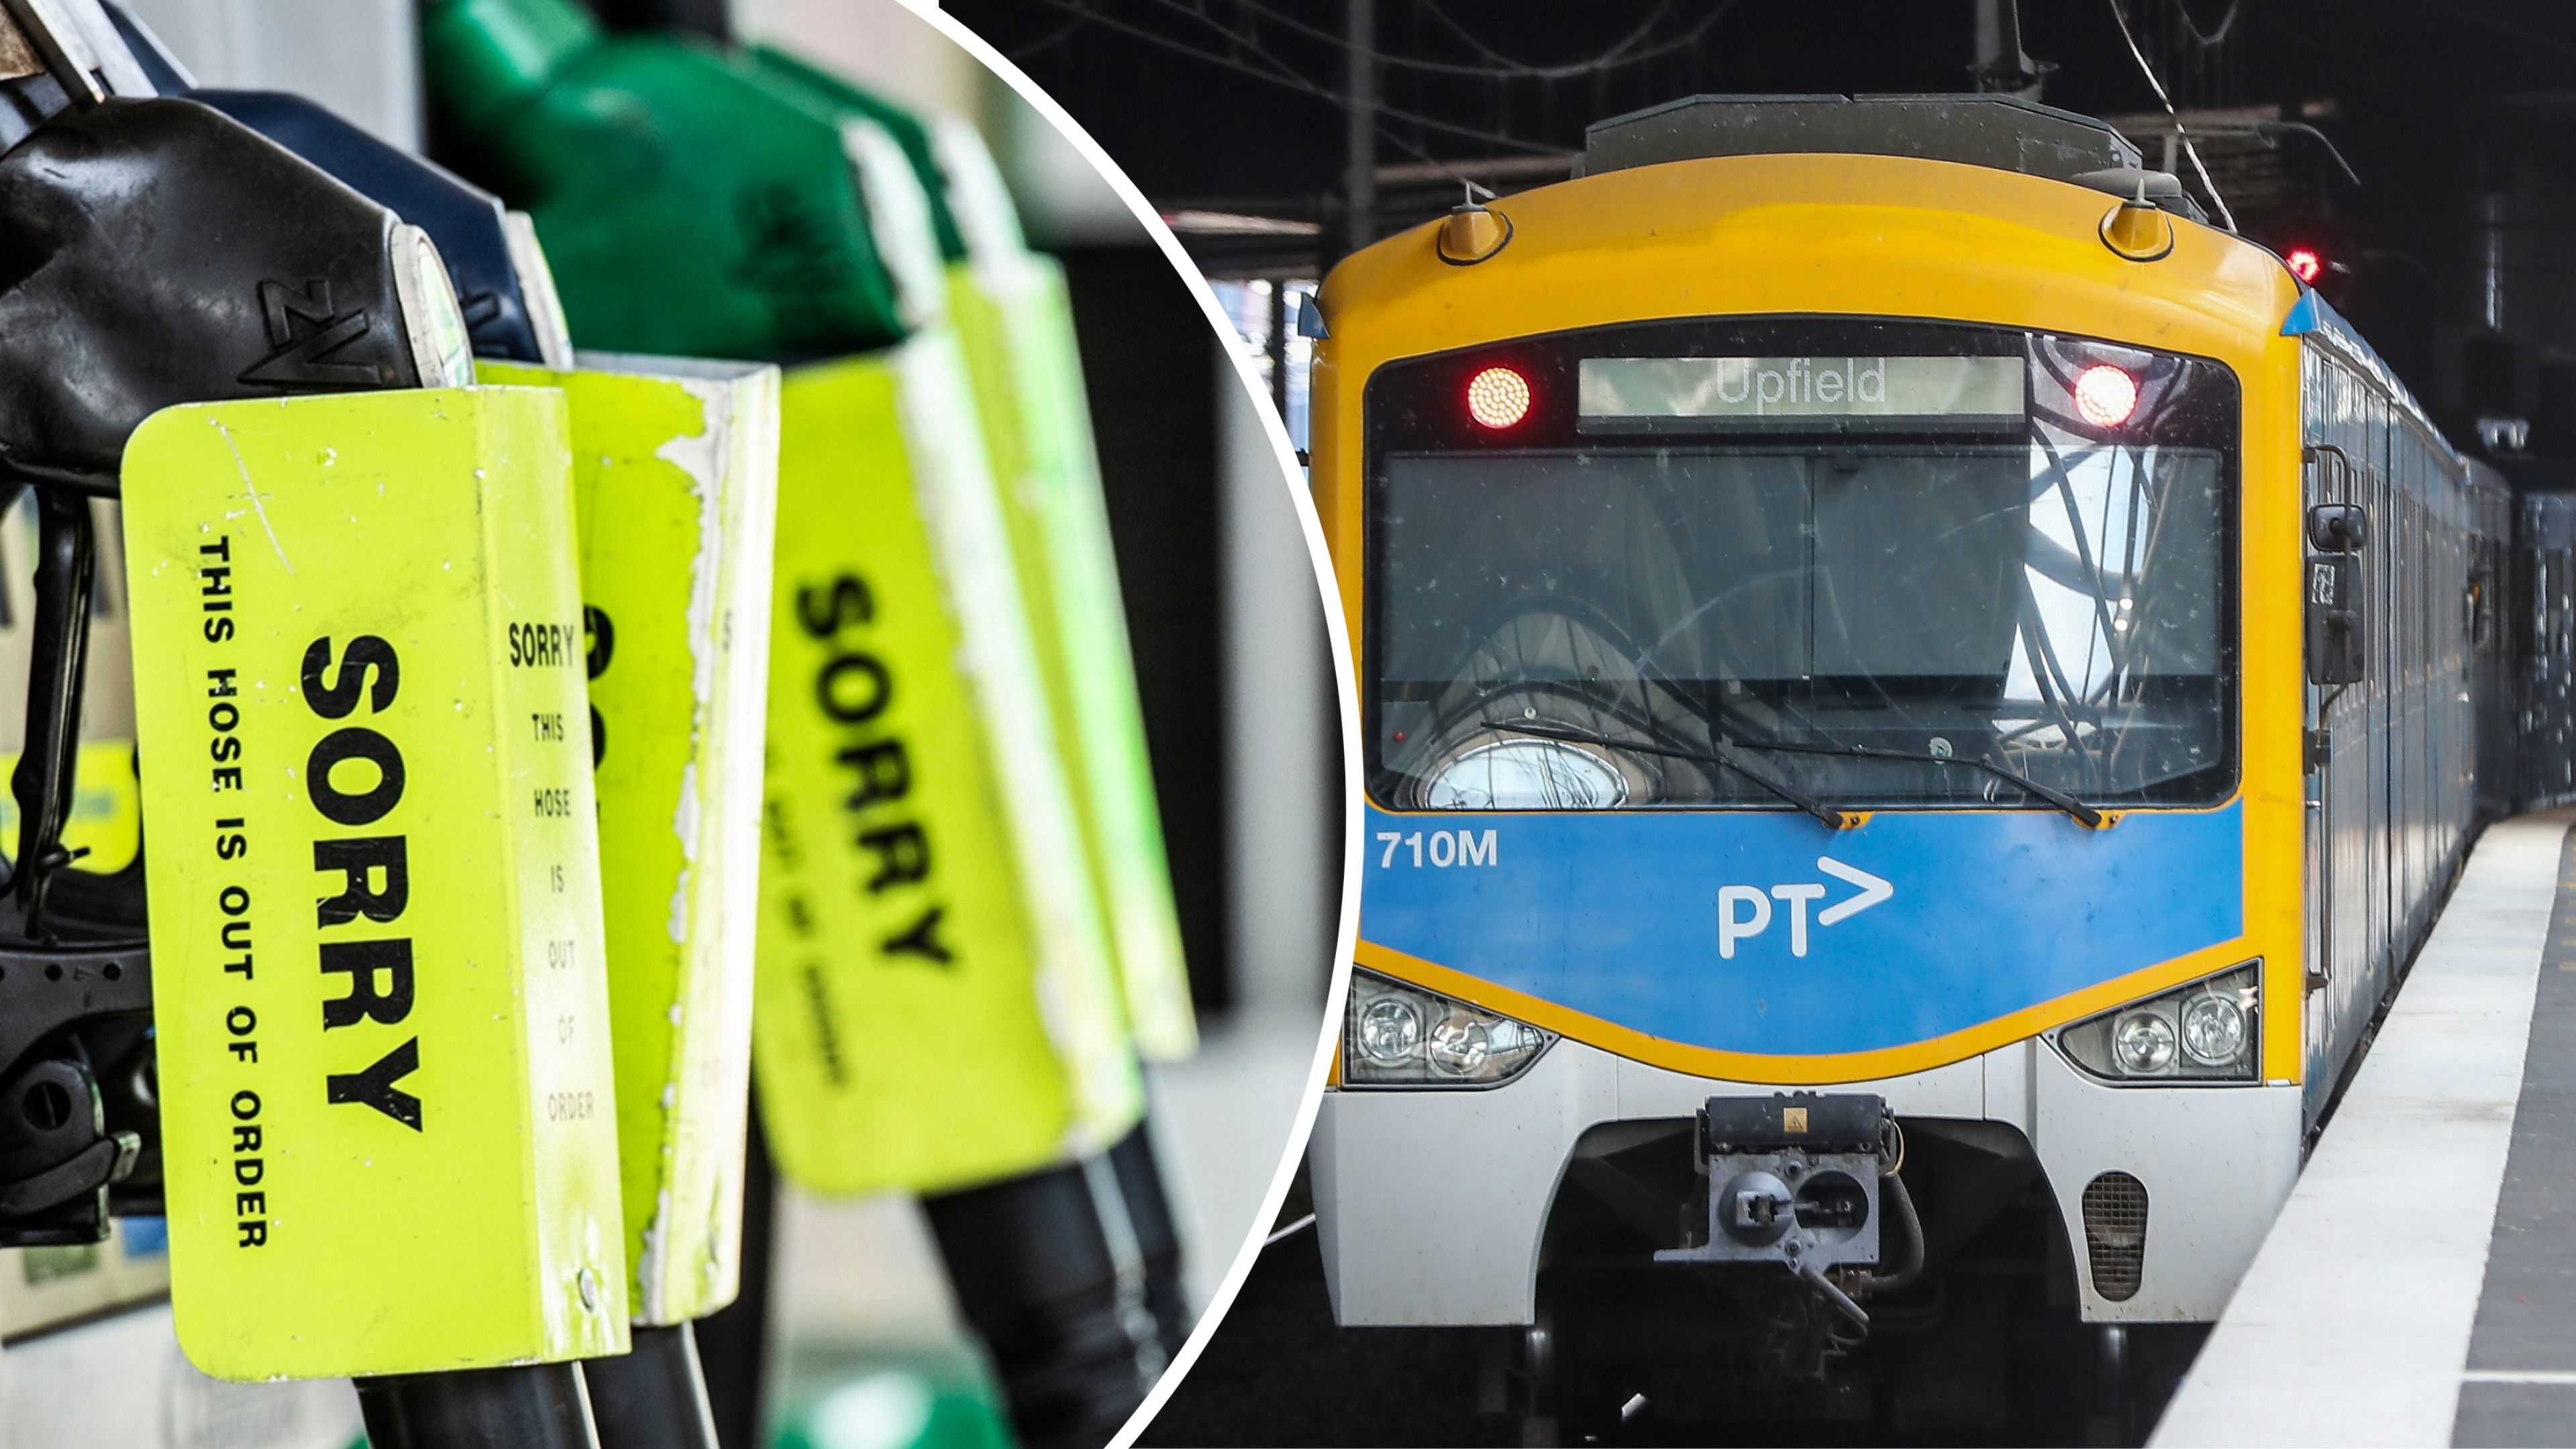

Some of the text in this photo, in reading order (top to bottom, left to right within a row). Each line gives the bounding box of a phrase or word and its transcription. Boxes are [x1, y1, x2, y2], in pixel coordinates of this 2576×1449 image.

[1716, 357, 1885, 415] Upfield
[508, 621, 574, 667] SORRY
[531, 713, 564, 742] THIS
[794, 572, 954, 966] SORRY
[534, 789, 570, 817] HOSE
[1377, 830, 1498, 868] 710M
[199, 536, 267, 1248] THIS HOSE IS OUT OF ORDER
[300, 634, 423, 1134] SORRY
[550, 864, 564, 893] IS
[548, 940, 575, 969] OUT
[558, 1015, 575, 1045] OF
[548, 1092, 595, 1122] ORDER
